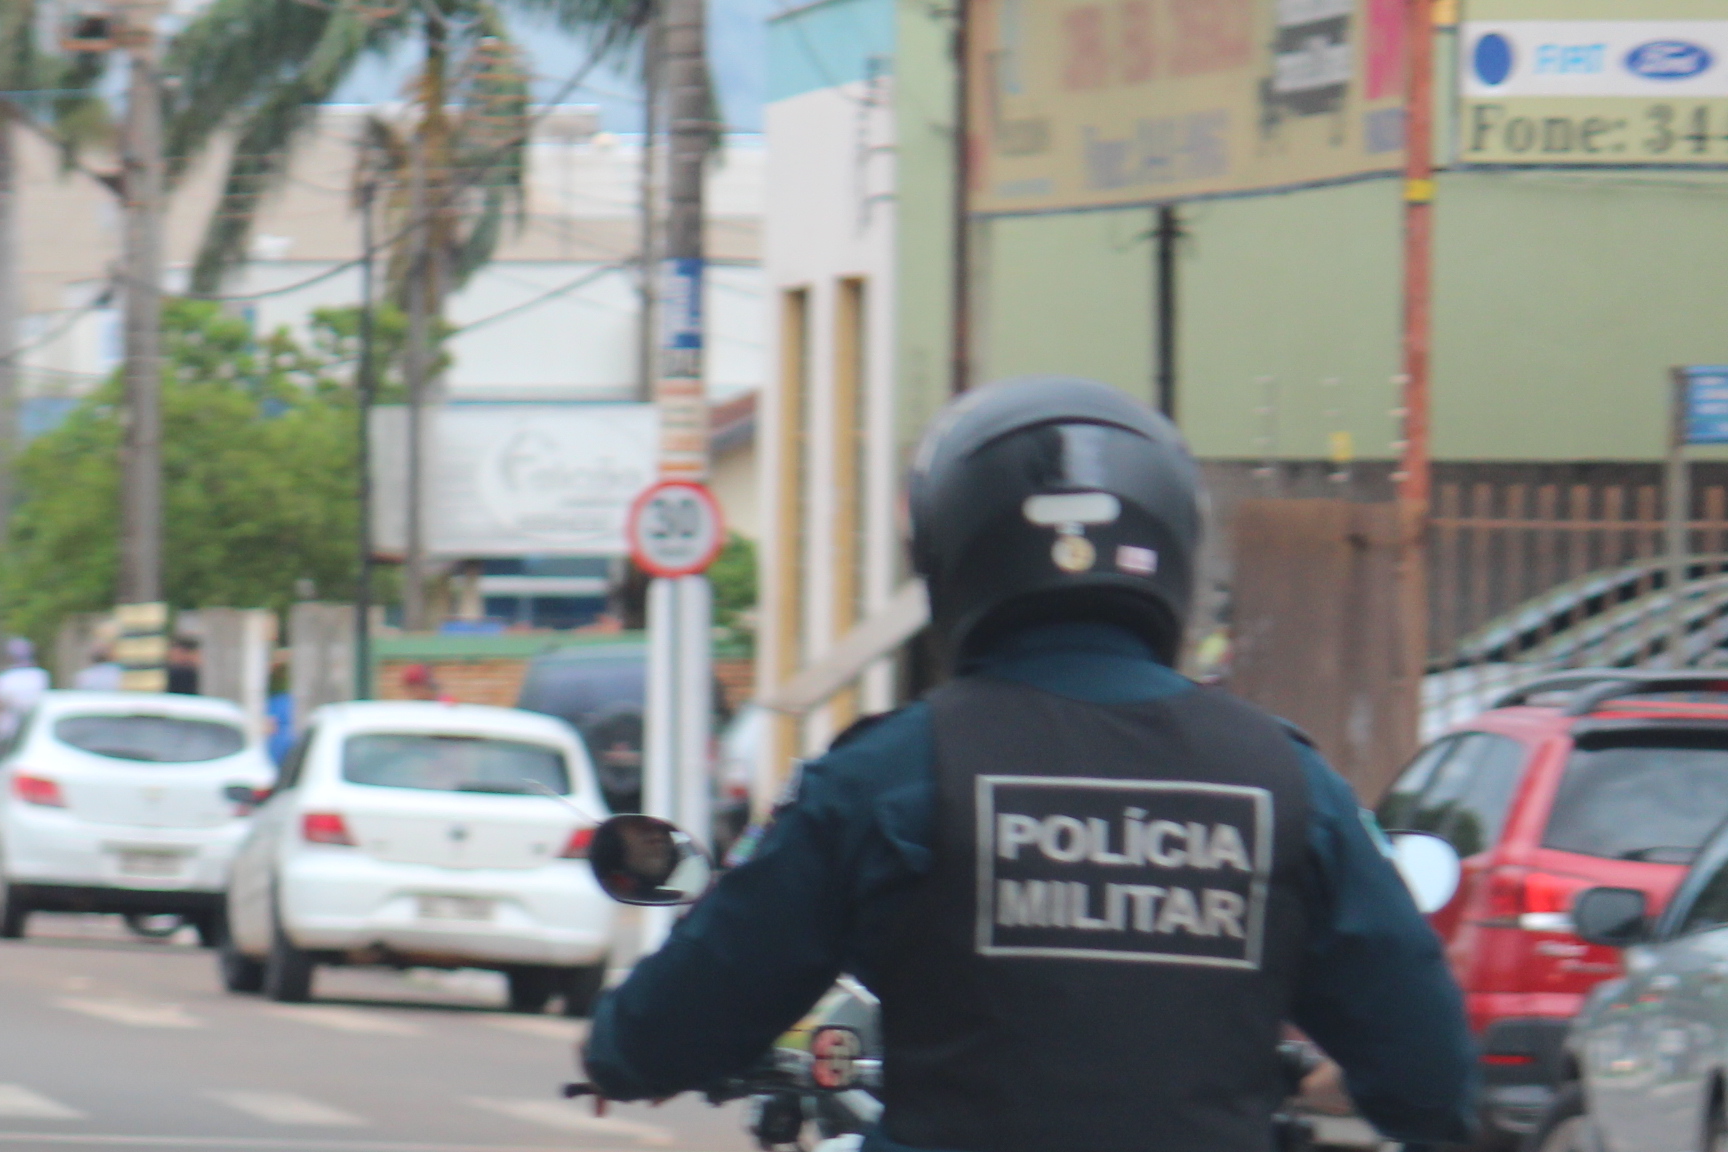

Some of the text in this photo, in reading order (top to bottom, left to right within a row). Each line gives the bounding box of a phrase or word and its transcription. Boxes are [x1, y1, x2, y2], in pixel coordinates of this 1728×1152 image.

[1471, 103, 1626, 153] Fone:
[996, 805, 1253, 873] POLÍCIA
[995, 878, 1248, 940] MILITAR
